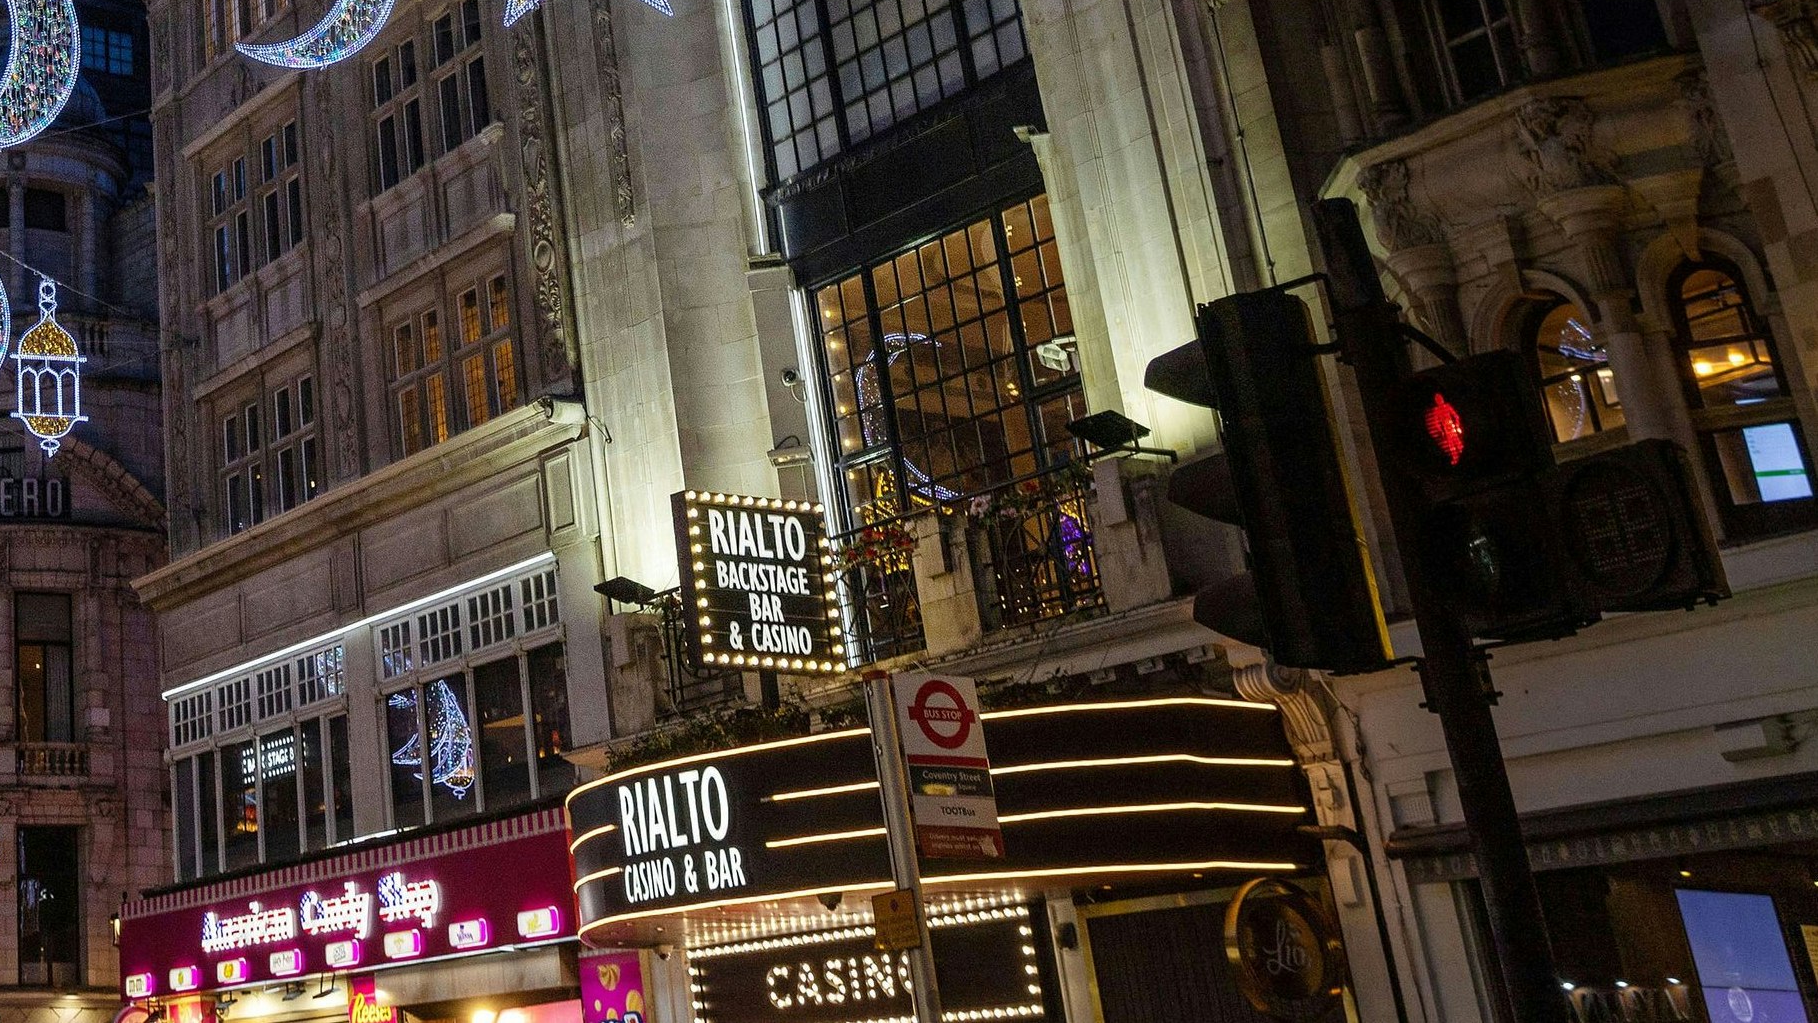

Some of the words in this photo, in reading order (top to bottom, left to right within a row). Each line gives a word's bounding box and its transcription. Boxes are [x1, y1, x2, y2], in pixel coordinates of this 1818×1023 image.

[708, 509, 806, 561] RIALTO
[716, 560, 810, 595] BACKSTAGE
[749, 592, 785, 623] BAR
[729, 620, 744, 650] &
[751, 622, 813, 655] CASINO
[923, 708, 939, 720] BUS
[941, 709, 963, 721] STOP
[922, 769, 958, 782] Coventry
[958, 771, 981, 782] Street
[618, 765, 729, 857] RIALTO
[625, 857, 676, 904] CASINO
[684, 854, 699, 893] &
[704, 847, 747, 890] BAR
[202, 901, 294, 953] American
[300, 880, 370, 940] Candy
[377, 871, 439, 928] Shop
